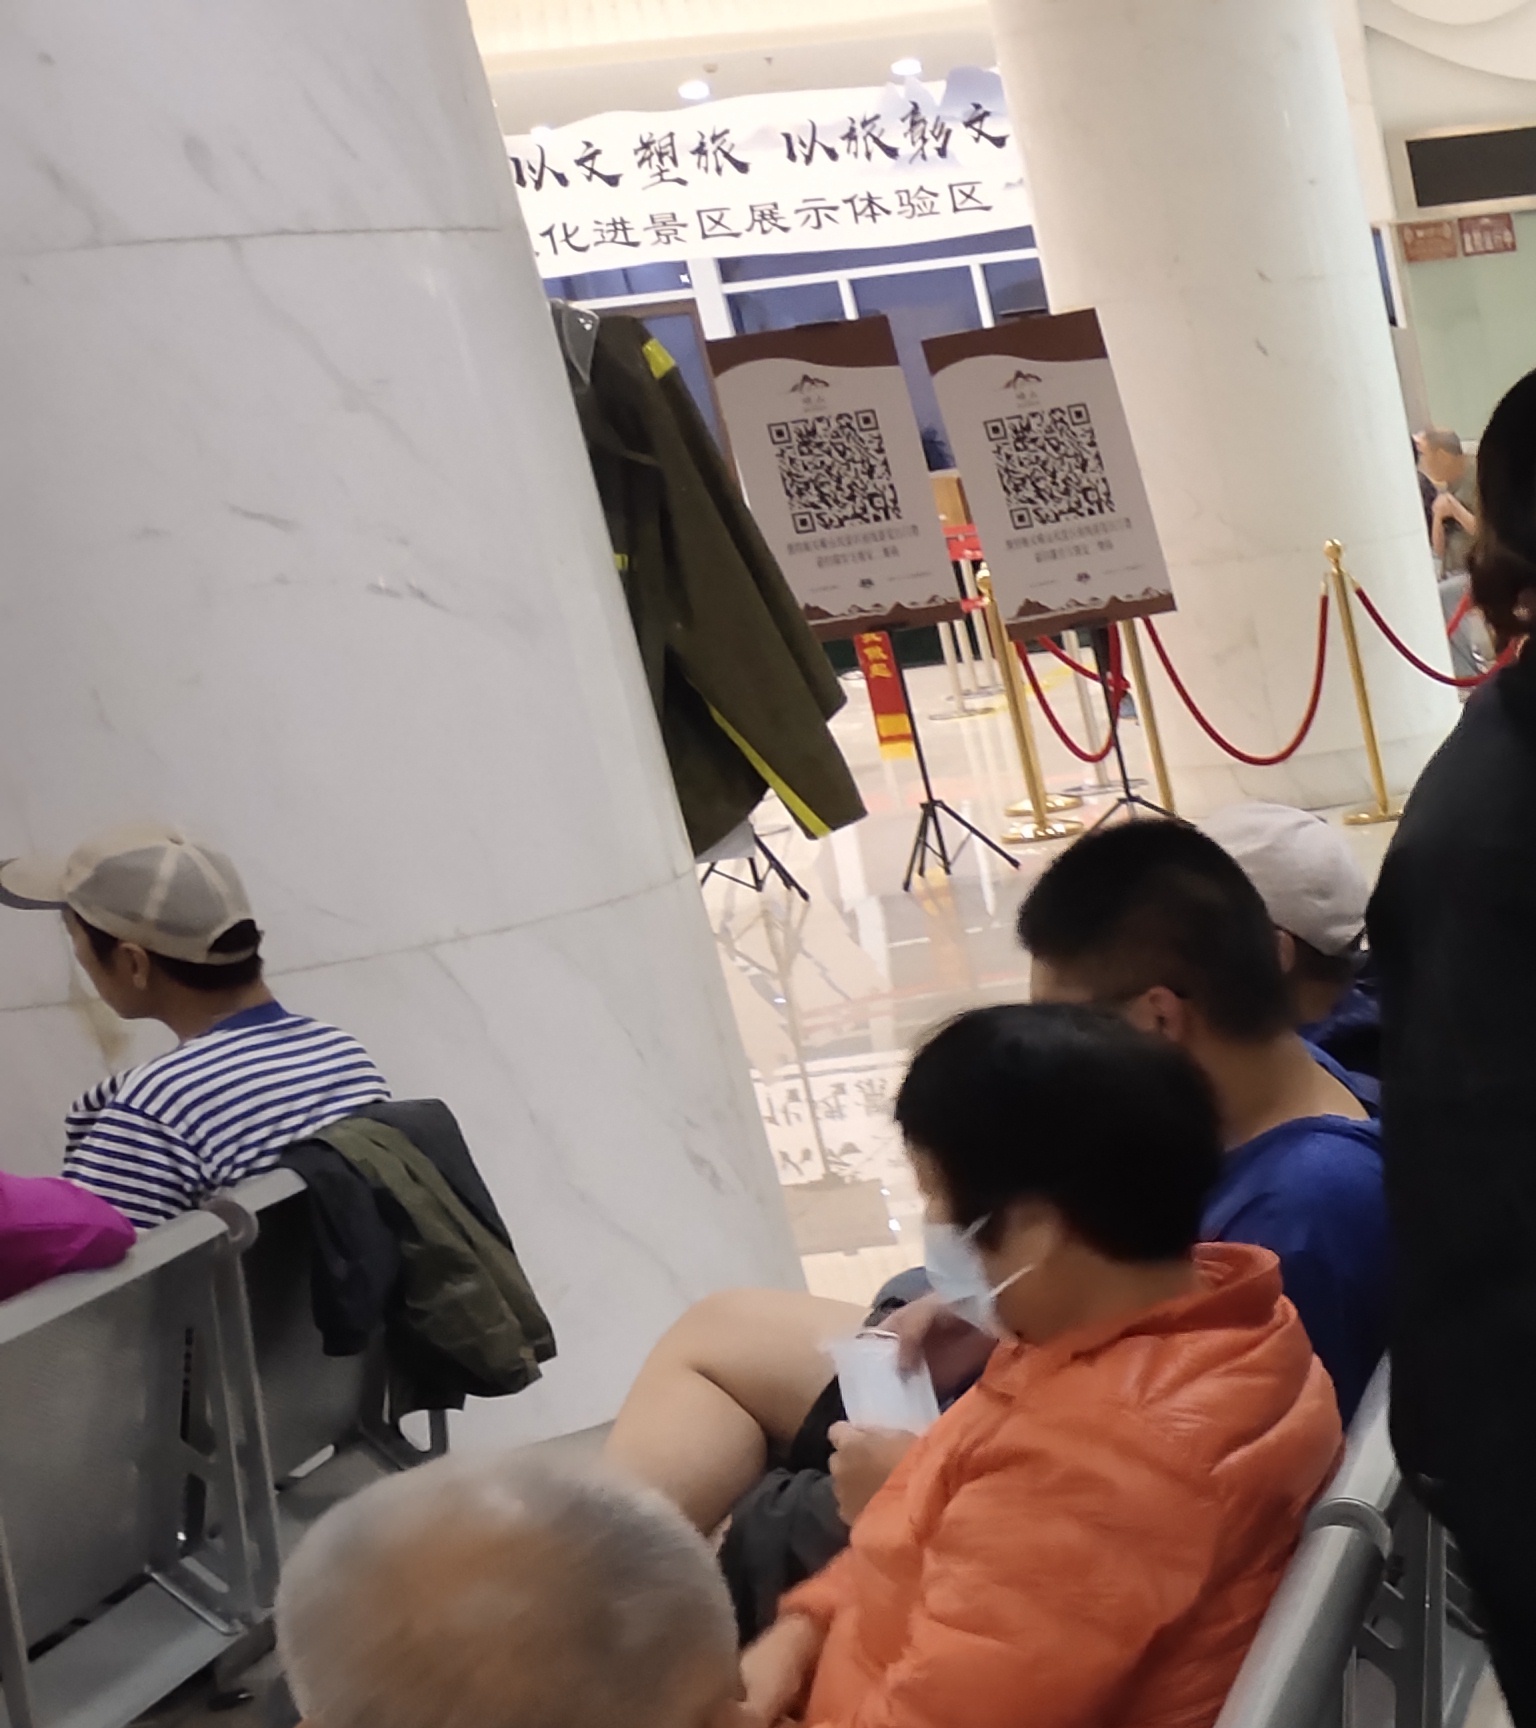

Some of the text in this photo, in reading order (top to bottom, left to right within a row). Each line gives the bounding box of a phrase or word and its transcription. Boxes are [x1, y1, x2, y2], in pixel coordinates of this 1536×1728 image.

[510, 100, 1010, 192] 以文塑旅 以旅彰文
[535, 181, 993, 257] 化进景区展示体验区
